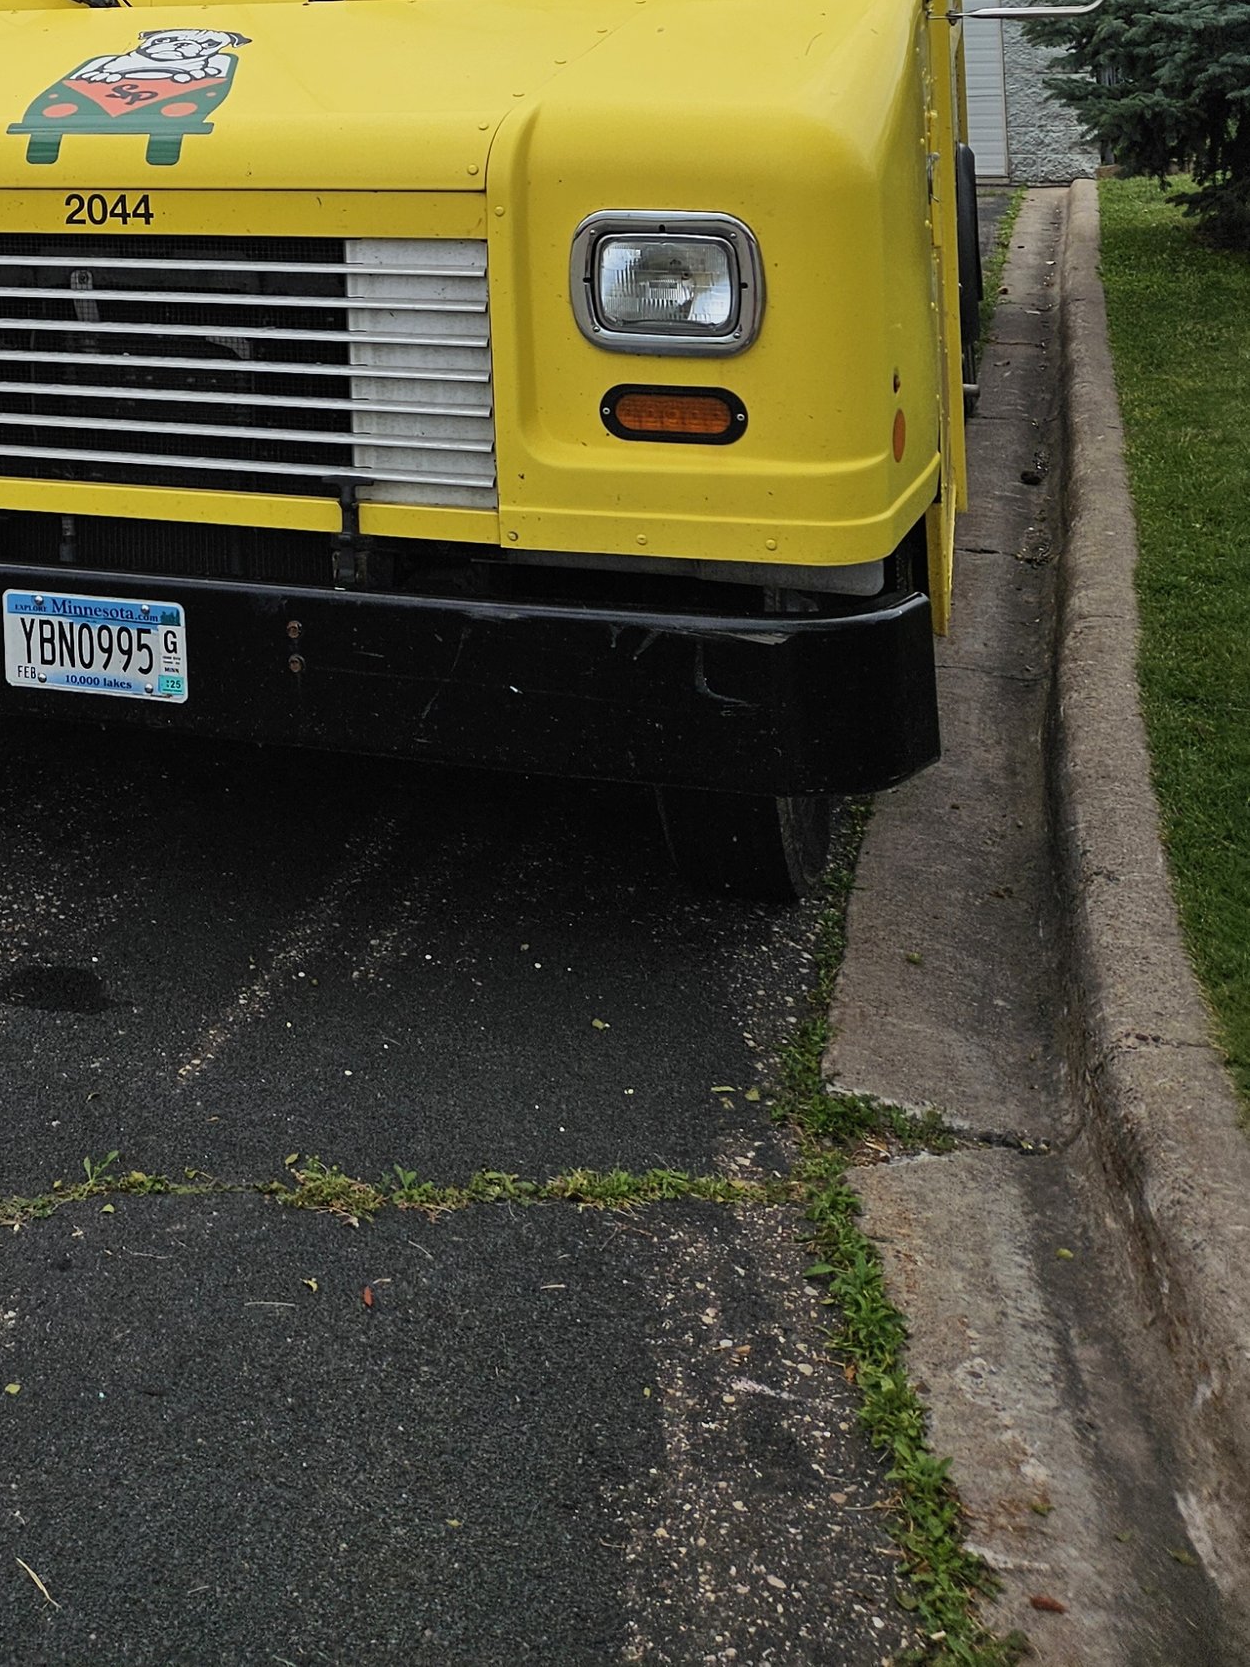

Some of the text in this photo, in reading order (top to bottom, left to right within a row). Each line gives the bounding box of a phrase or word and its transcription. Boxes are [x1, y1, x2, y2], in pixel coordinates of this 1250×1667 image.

[64, 193, 155, 225] 2044
[19, 617, 154, 676] YBN0995
[163, 629, 178, 655] G
[17, 665, 37, 680] FEB
[65, 674, 133, 690] 10,000 lakes
